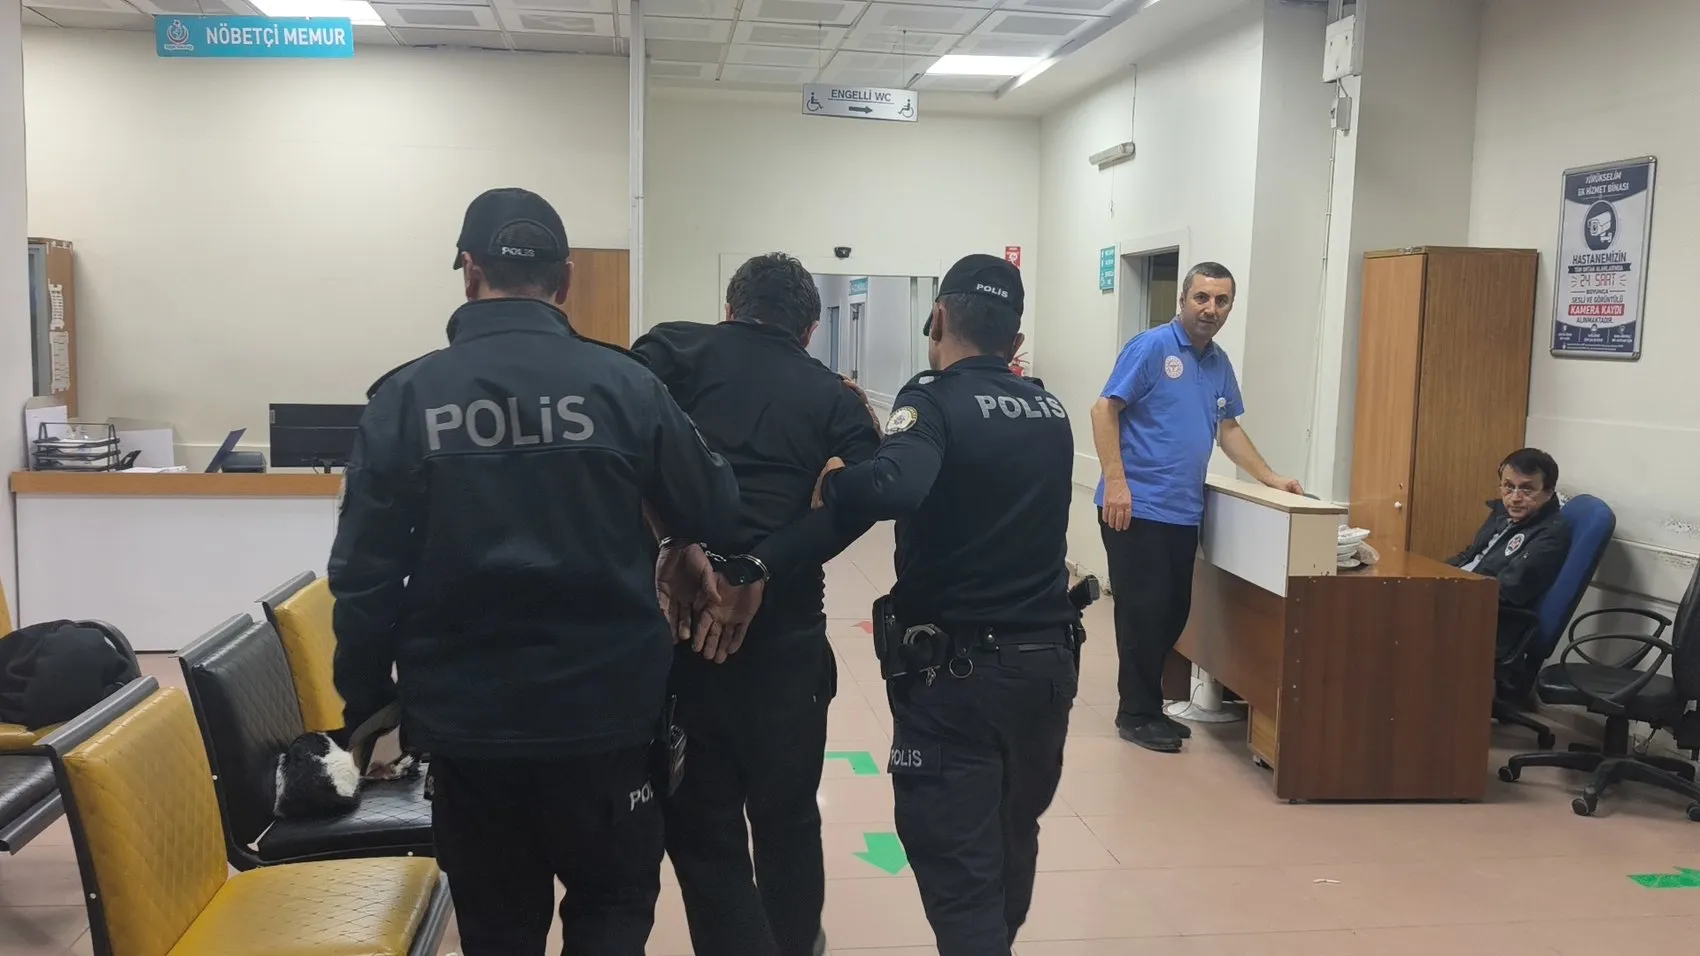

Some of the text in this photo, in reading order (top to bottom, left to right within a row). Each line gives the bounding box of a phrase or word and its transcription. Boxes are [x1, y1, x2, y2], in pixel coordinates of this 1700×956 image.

[206, 23, 346, 48] NÖBETÇİ MEMUR
[831, 89, 892, 102] ENGELLİ WC
[1572, 249, 1627, 264] HASTANEMİZİN
[1580, 273, 1617, 287] 24 SAAT
[1570, 304, 1623, 315] KAMERA KAYDI
